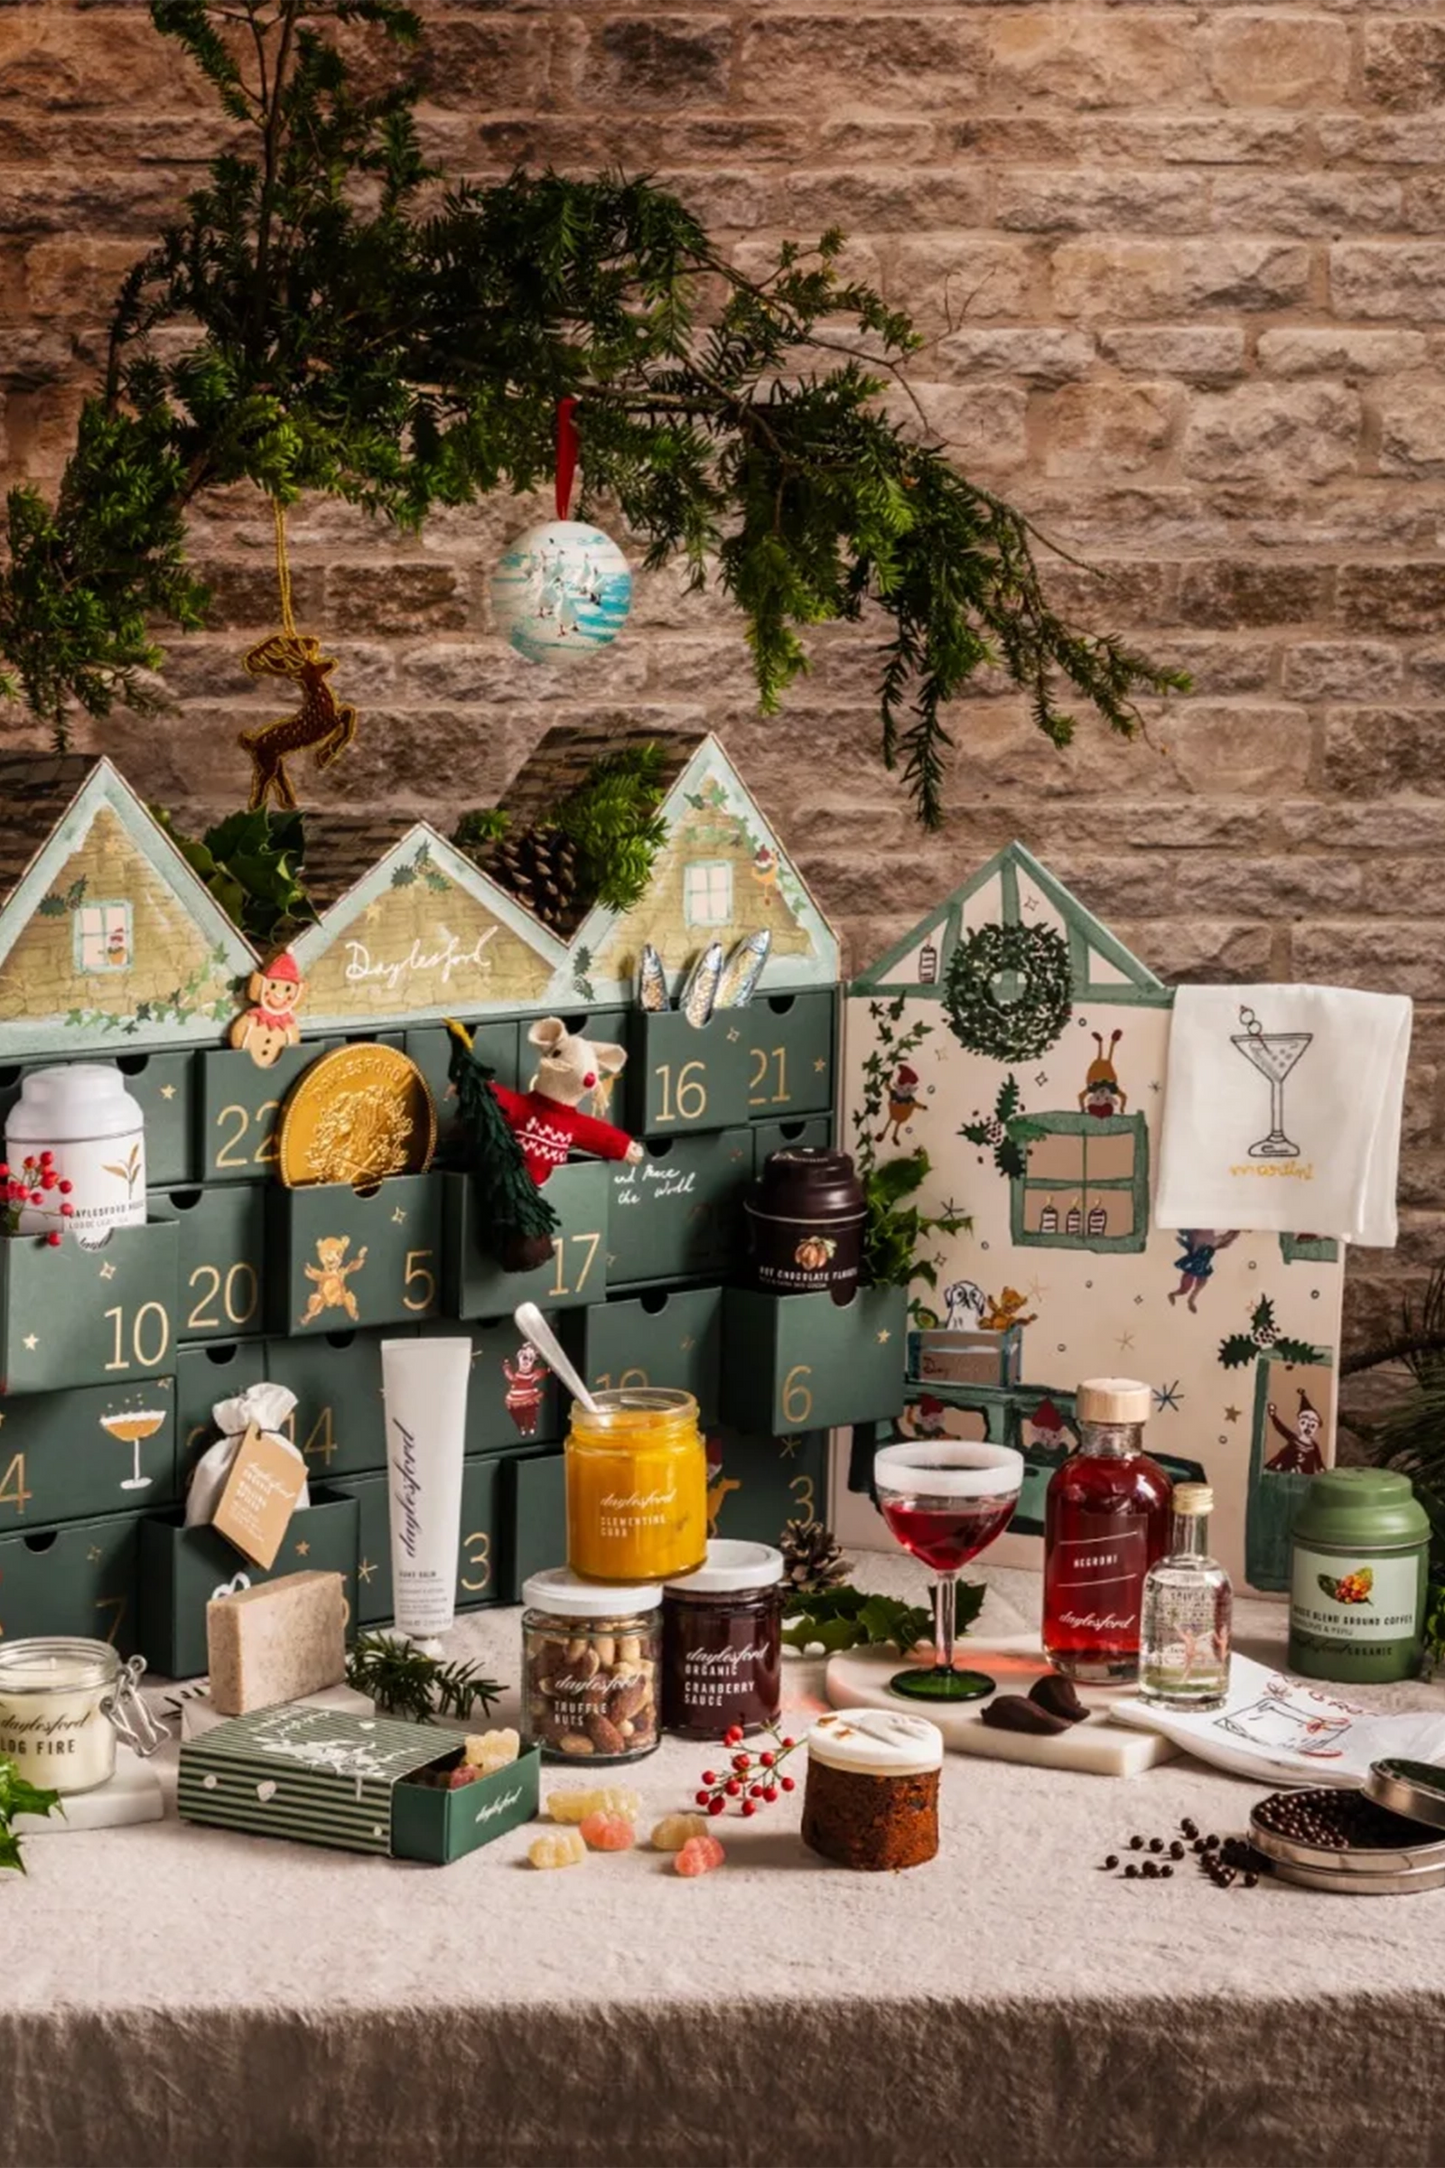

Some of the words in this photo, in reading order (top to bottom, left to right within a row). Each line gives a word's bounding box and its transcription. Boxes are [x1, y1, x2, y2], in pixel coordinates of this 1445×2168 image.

[344, 924, 499, 989] Daylesford
[308, 1057, 402, 1102] DAYLESFORD
[749, 1047, 791, 1106] 21
[654, 1060, 707, 1122] 16
[617, 1188, 641, 1206] the
[69, 1204, 126, 1219] AYLESFORD
[549, 1232, 601, 1297] 17
[776, 1269, 830, 1282] CHOCOLATE
[402, 1249, 435, 1312] 5
[187, 1262, 258, 1329] 20
[104, 1301, 169, 1371] 10
[782, 1364, 813, 1424] 6
[393, 1417, 423, 1559] daylesford
[600, 1488, 677, 1511] daylesford
[1058, 1610, 1137, 1632] daylesford
[1313, 1610, 1340, 1624] BLEND
[1343, 1615, 1380, 1627] GROUND
[685, 1641, 770, 1671] daylesford
[684, 1662, 738, 1677] ORGANIC
[554, 1672, 643, 1695] daylesford
[684, 1680, 755, 1694] CRANBERRY
[554, 1699, 608, 1715] TRUFFLE
[684, 1693, 723, 1707] SAUCE
[0, 1710, 91, 1736] daylesford
[554, 1712, 584, 1727] NUTS
[0, 1739, 27, 1755] LOG
[36, 1739, 76, 1756] FIRE
